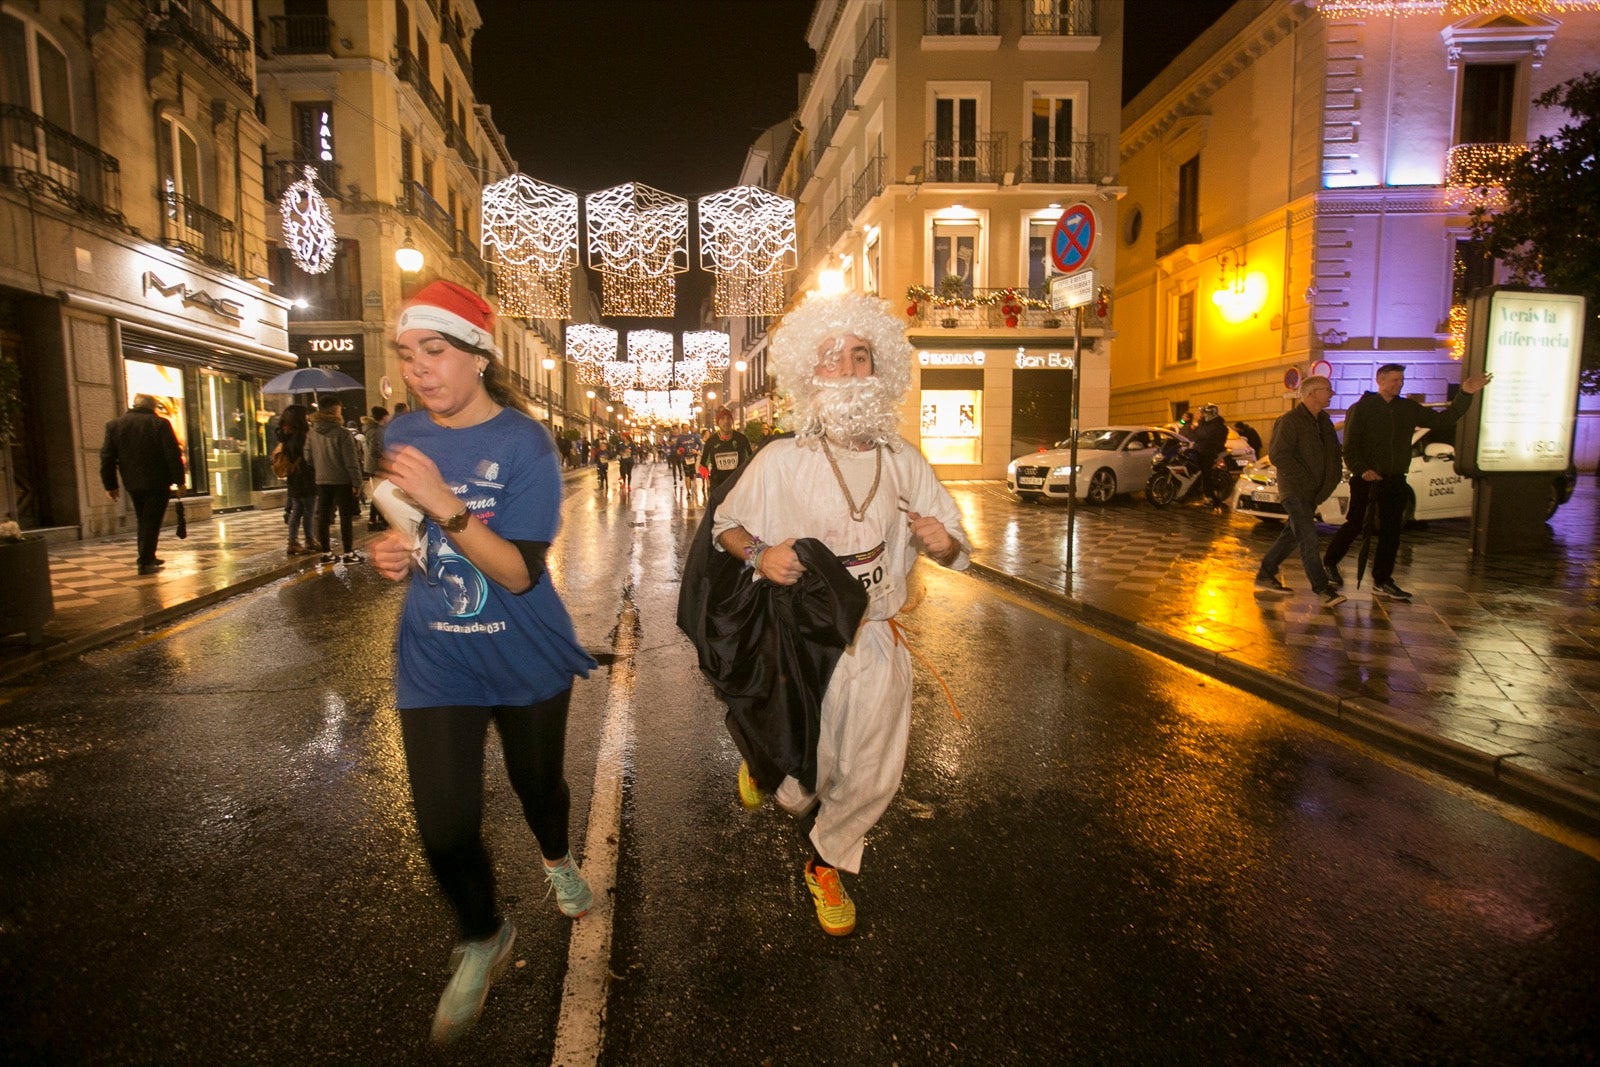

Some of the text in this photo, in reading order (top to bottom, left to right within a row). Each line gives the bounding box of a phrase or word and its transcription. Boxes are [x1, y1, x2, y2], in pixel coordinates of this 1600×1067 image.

[1544, 308, 1557, 323] la
[308, 338, 354, 351] TOUS
[1498, 331, 1569, 348] diferencia
[1429, 487, 1455, 497] LOCAL
